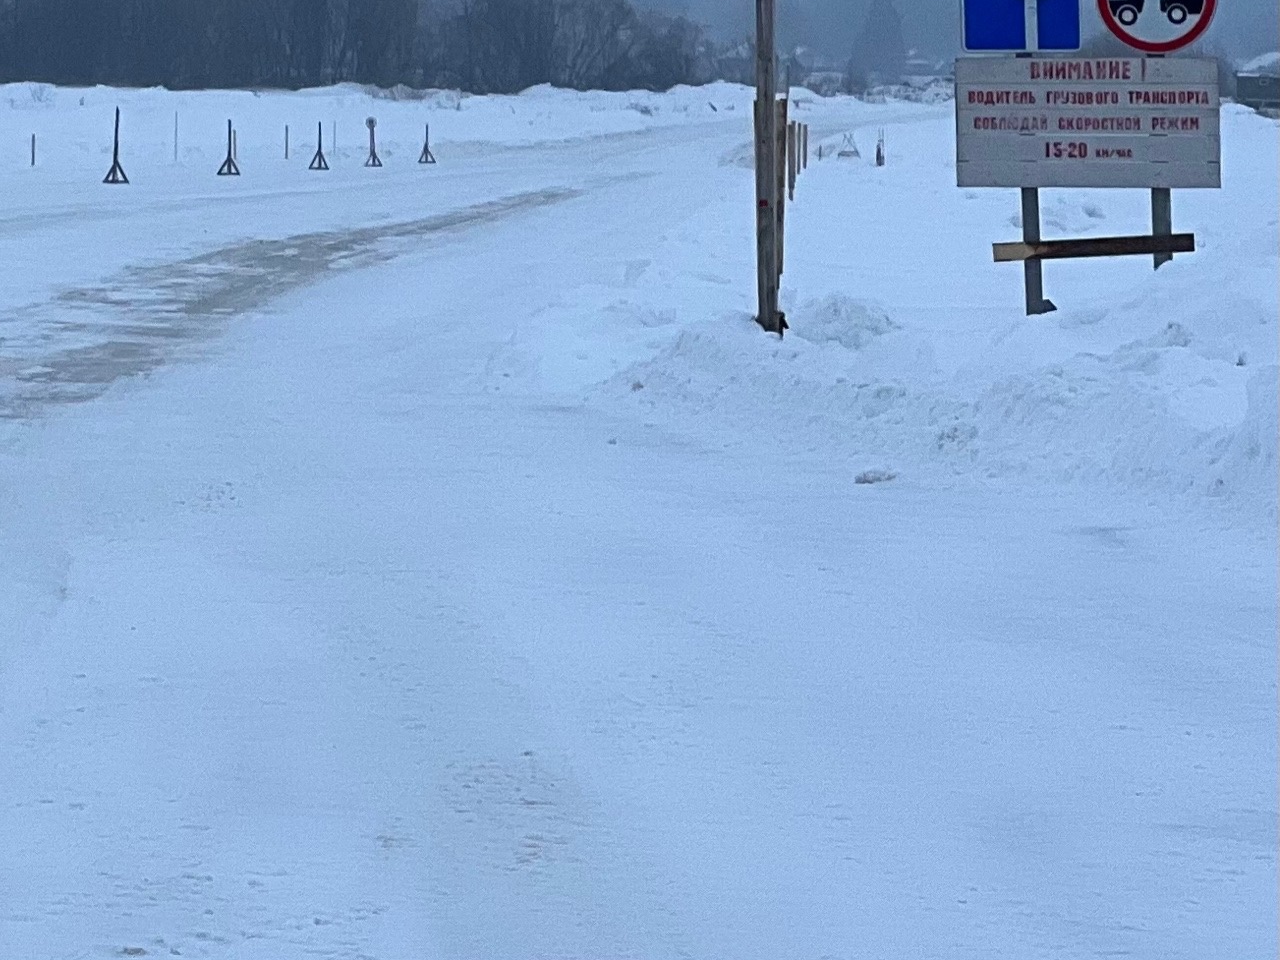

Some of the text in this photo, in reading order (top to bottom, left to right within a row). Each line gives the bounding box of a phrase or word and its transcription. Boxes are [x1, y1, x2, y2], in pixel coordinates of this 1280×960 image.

[968, 90, 1210, 106] ВОДИТЕЛЬ ГРУЗОВОГО ТРАНСПОРТА
[973, 114, 1200, 131] СОБЛЮДАЙ СКОРОСТНОЙ РЕЖИМ
[1045, 142, 1088, 159] 15-20
